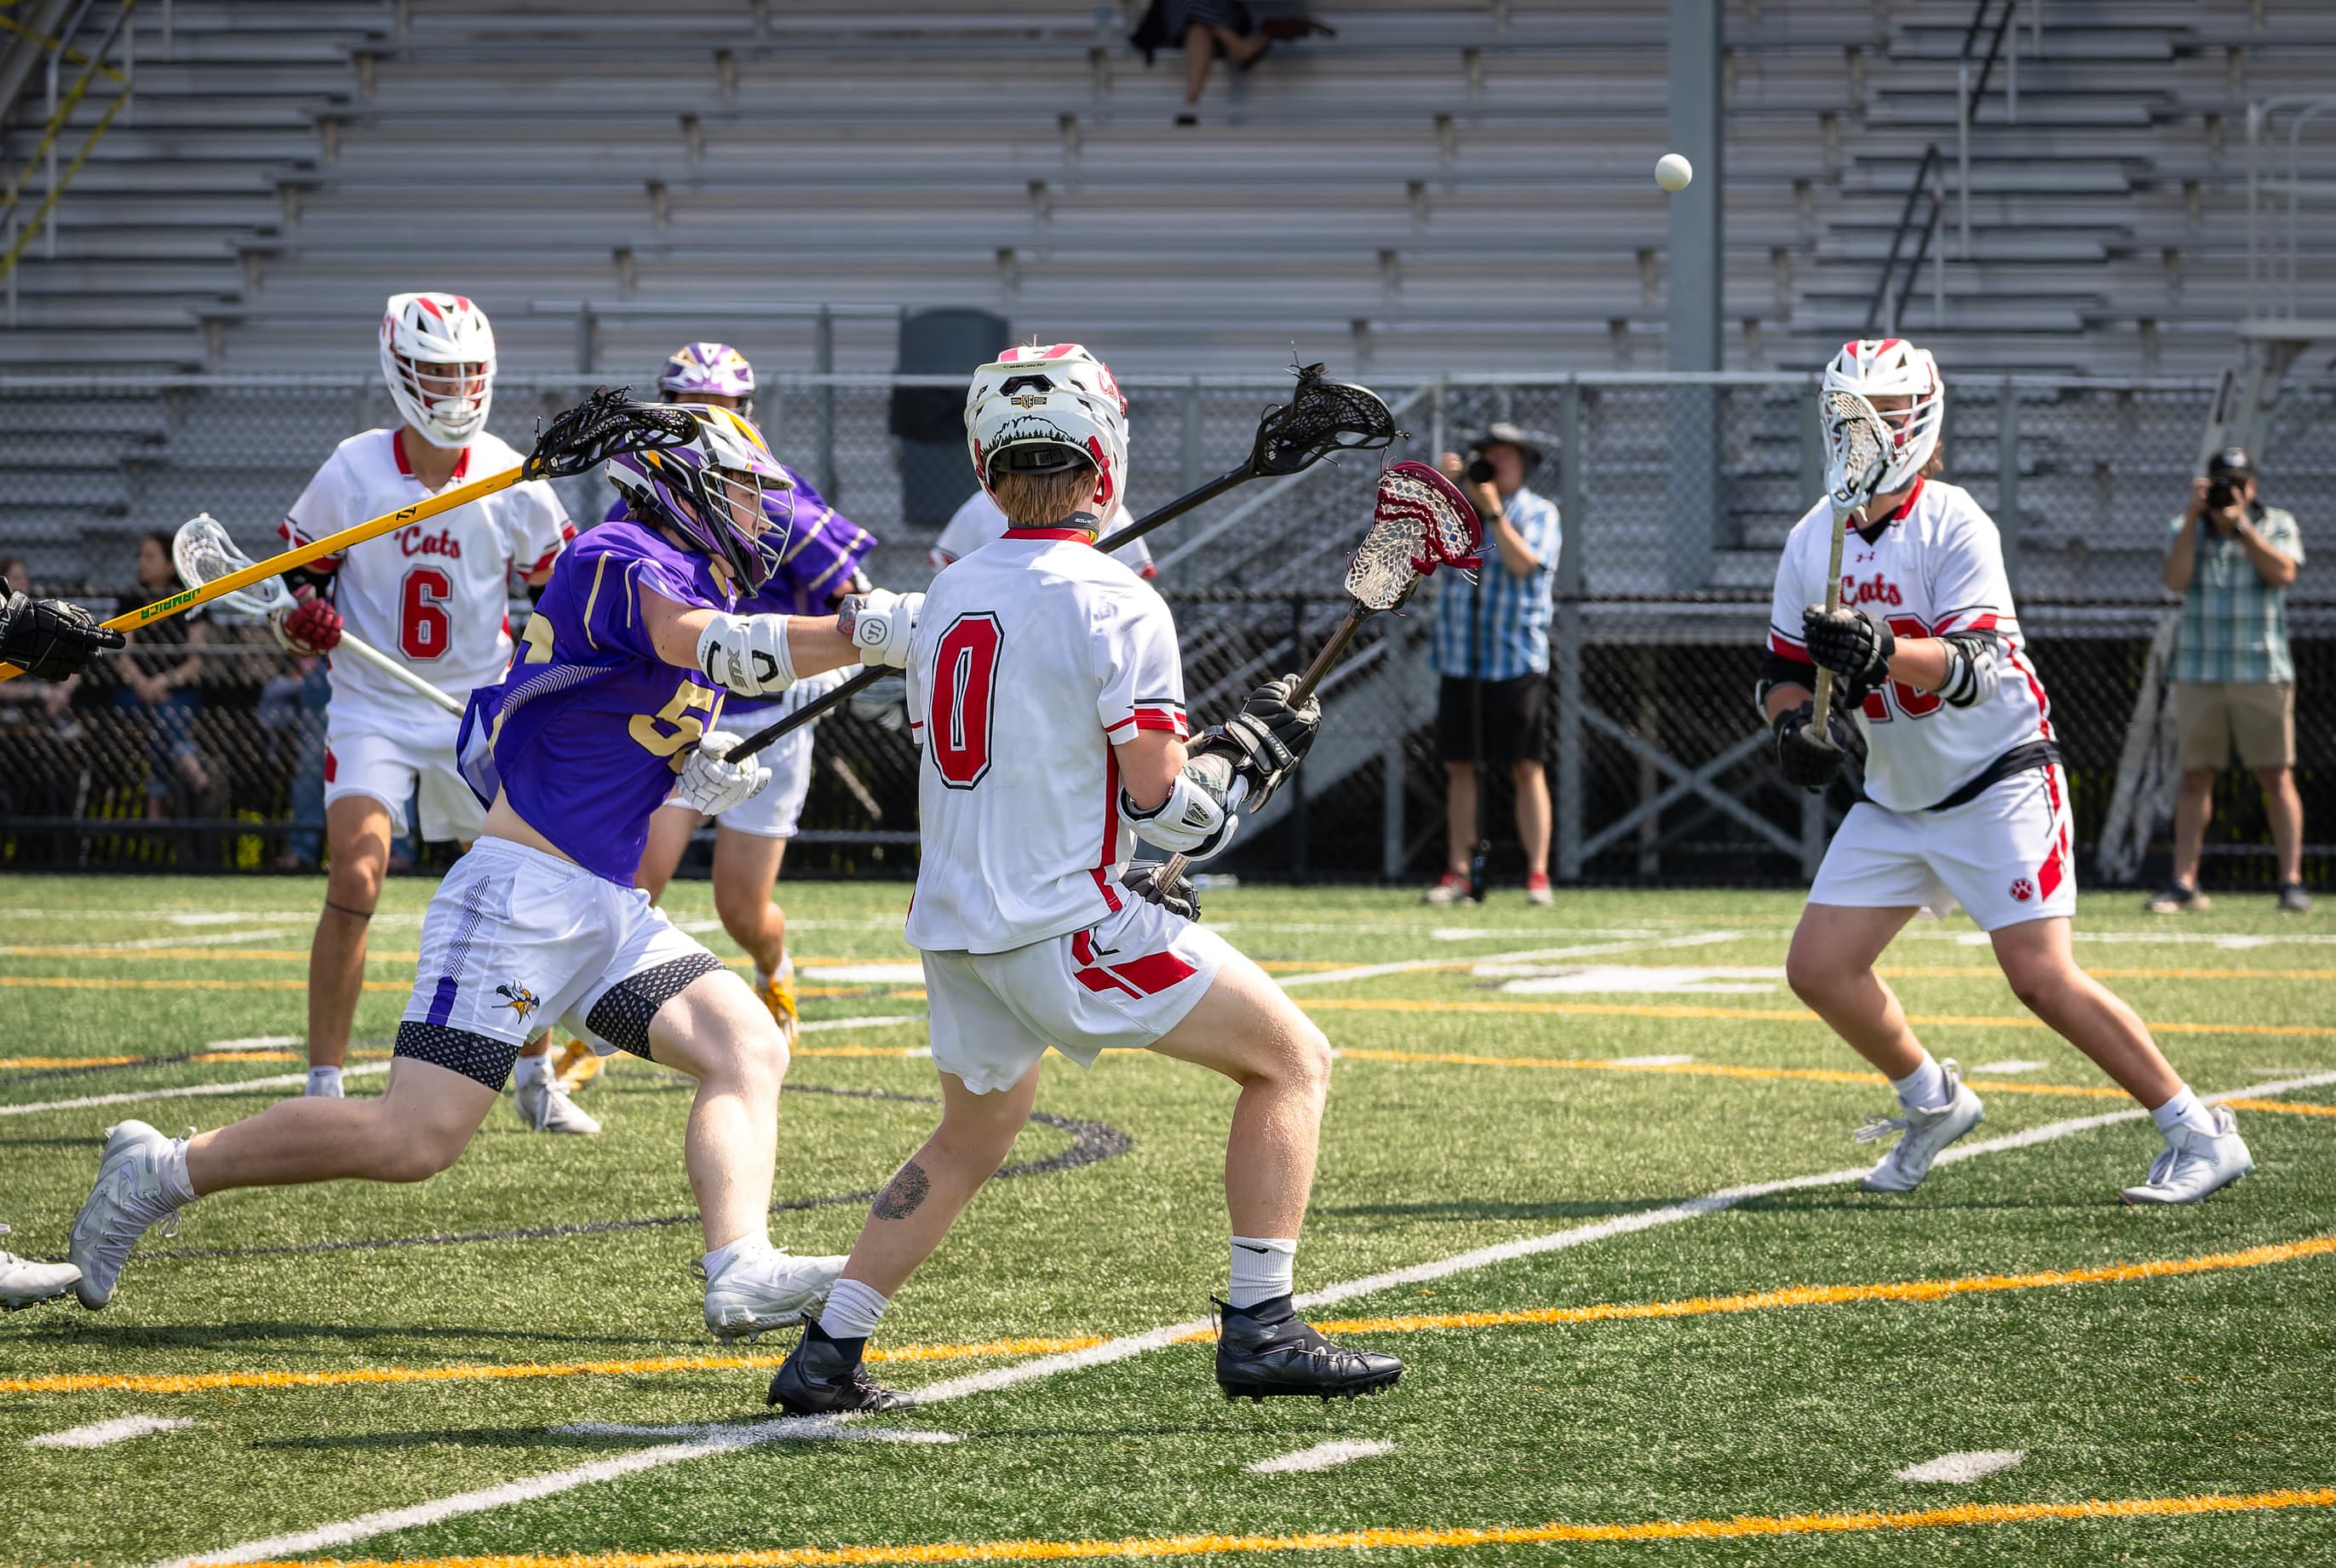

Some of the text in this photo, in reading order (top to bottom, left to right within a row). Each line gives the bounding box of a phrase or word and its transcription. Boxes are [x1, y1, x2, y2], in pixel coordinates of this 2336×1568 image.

[141, 587, 202, 621] JAMAICA
[397, 563, 453, 663] 6
[727, 647, 749, 690] STX
[928, 611, 1005, 790] 0
